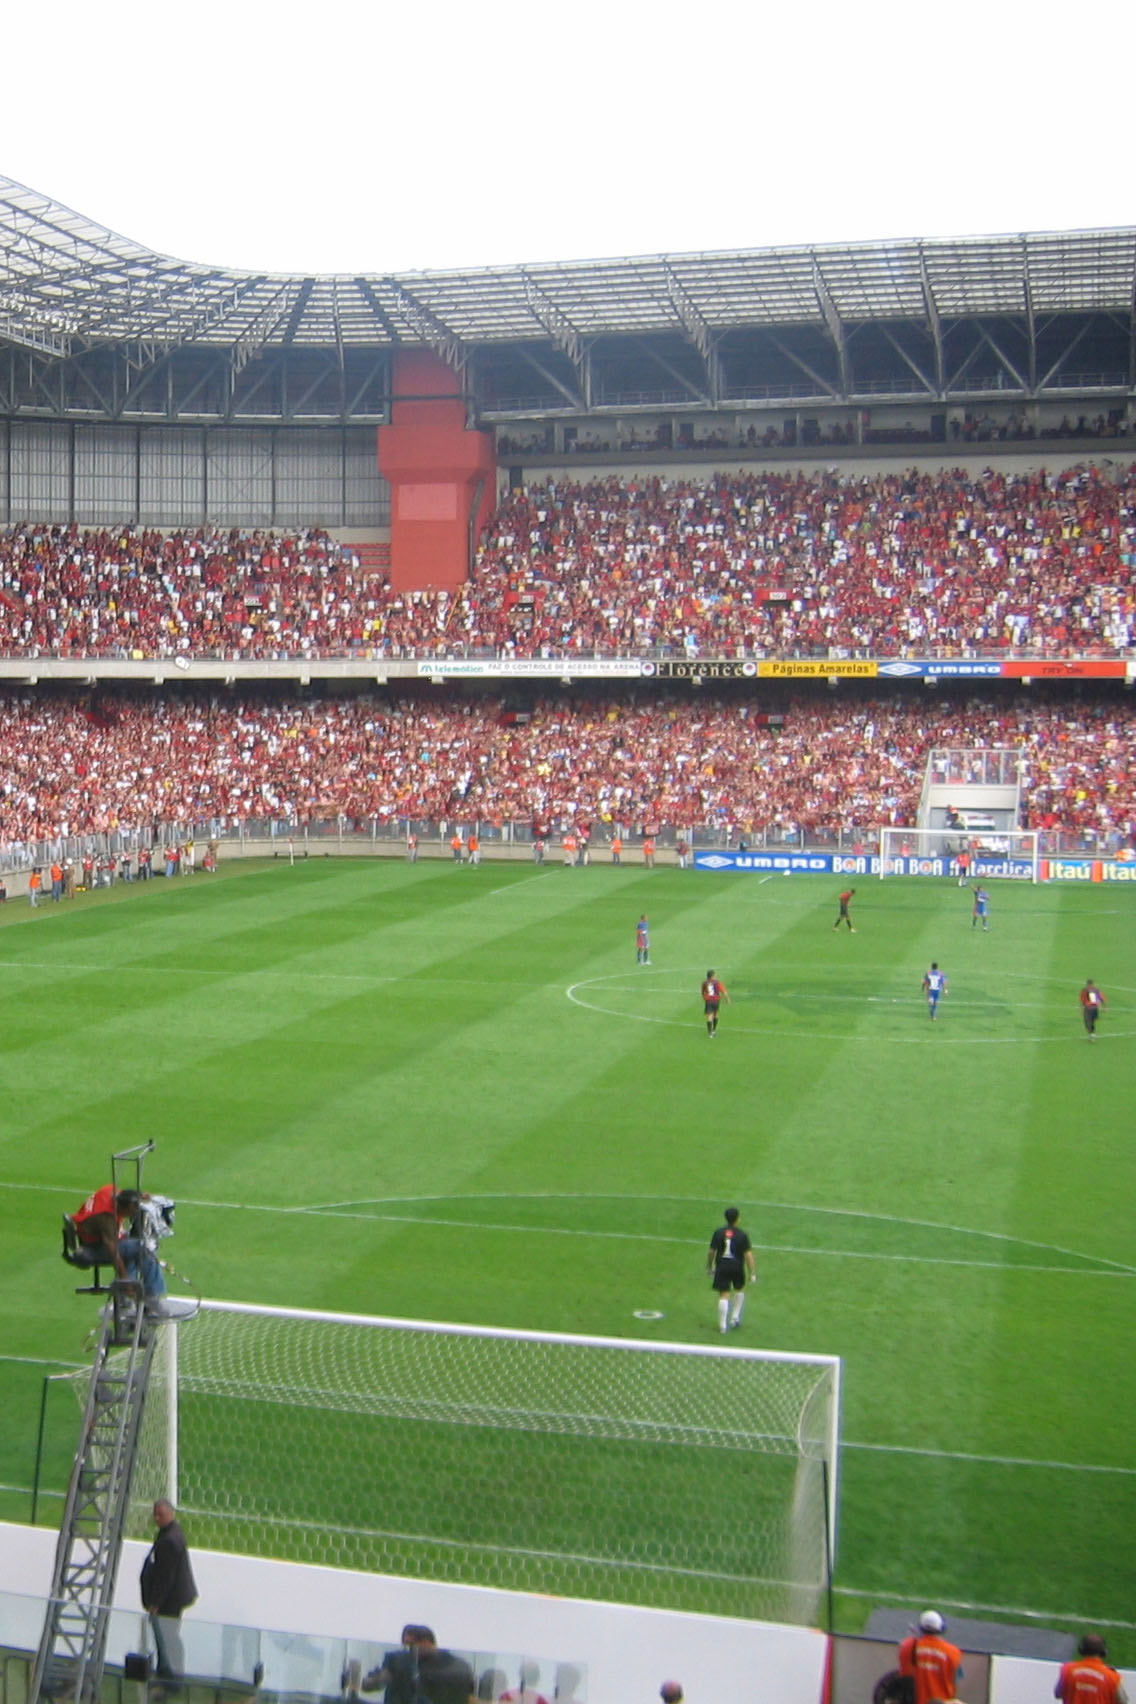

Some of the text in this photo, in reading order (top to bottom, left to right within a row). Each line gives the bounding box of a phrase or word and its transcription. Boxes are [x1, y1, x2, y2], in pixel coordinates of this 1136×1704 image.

[512, 663, 553, 671] CONTROLE
[554, 663, 565, 671] DE
[567, 663, 599, 671] ACESSO
[614, 663, 640, 671] ARENA
[655, 662, 744, 677] Florence
[772, 663, 870, 676] Páginas Amarelas
[832, 855, 866, 874] BOA
[909, 858, 943, 876] BOA
[949, 859, 1033, 877] Atarctica
[1049, 860, 1091, 879] Itaú
[721, 1238, 735, 1259] 1
